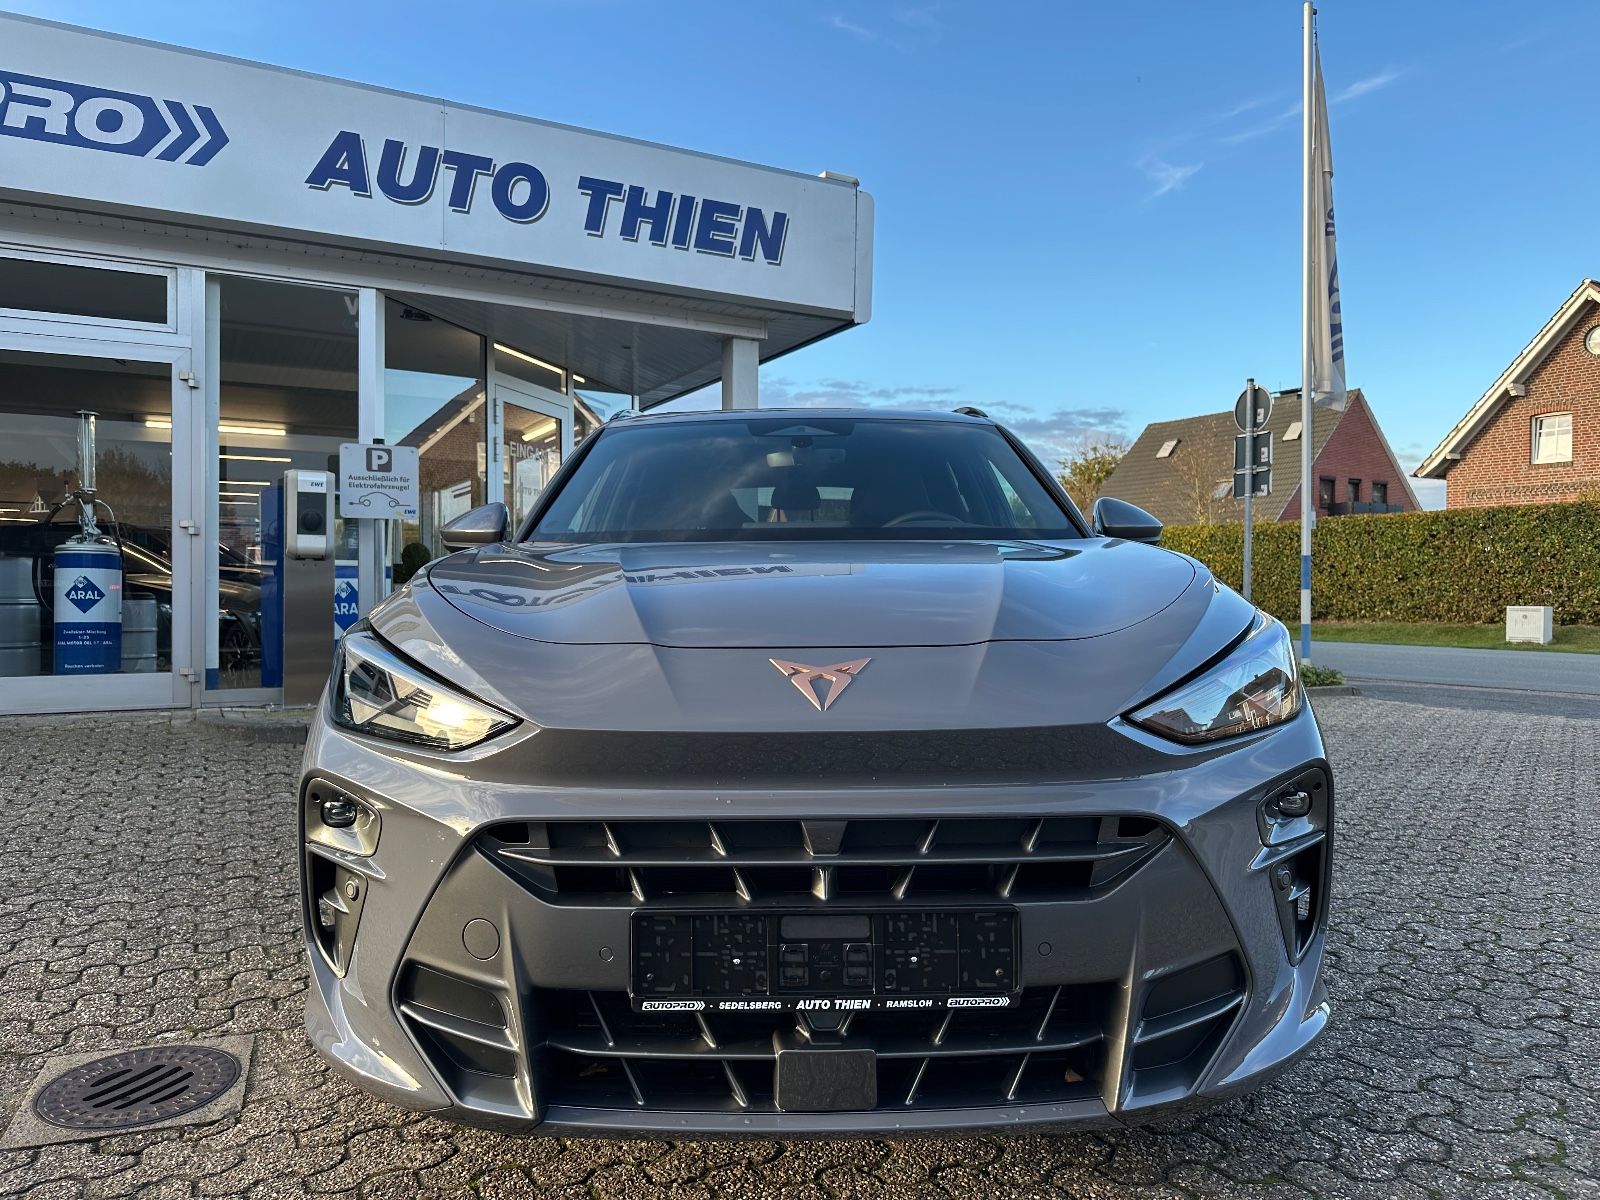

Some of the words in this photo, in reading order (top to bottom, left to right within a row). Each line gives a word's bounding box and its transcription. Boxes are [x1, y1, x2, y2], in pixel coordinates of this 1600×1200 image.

[0, 81, 145, 145] RO
[304, 129, 550, 224] AUTO
[577, 175, 789, 265] THIEN
[371, 450, 389, 470] P
[510, 441, 552, 465] EINGAN
[348, 474, 398, 483] Ausschließlich
[69, 590, 101, 600] ARAL
[334, 602, 359, 615] ARA
[719, 1001, 782, 1010] SEDELSBERG
[796, 1000, 831, 1010] AUTO
[834, 999, 871, 1010] THIEN
[886, 999, 933, 1008] RAMSLOH
